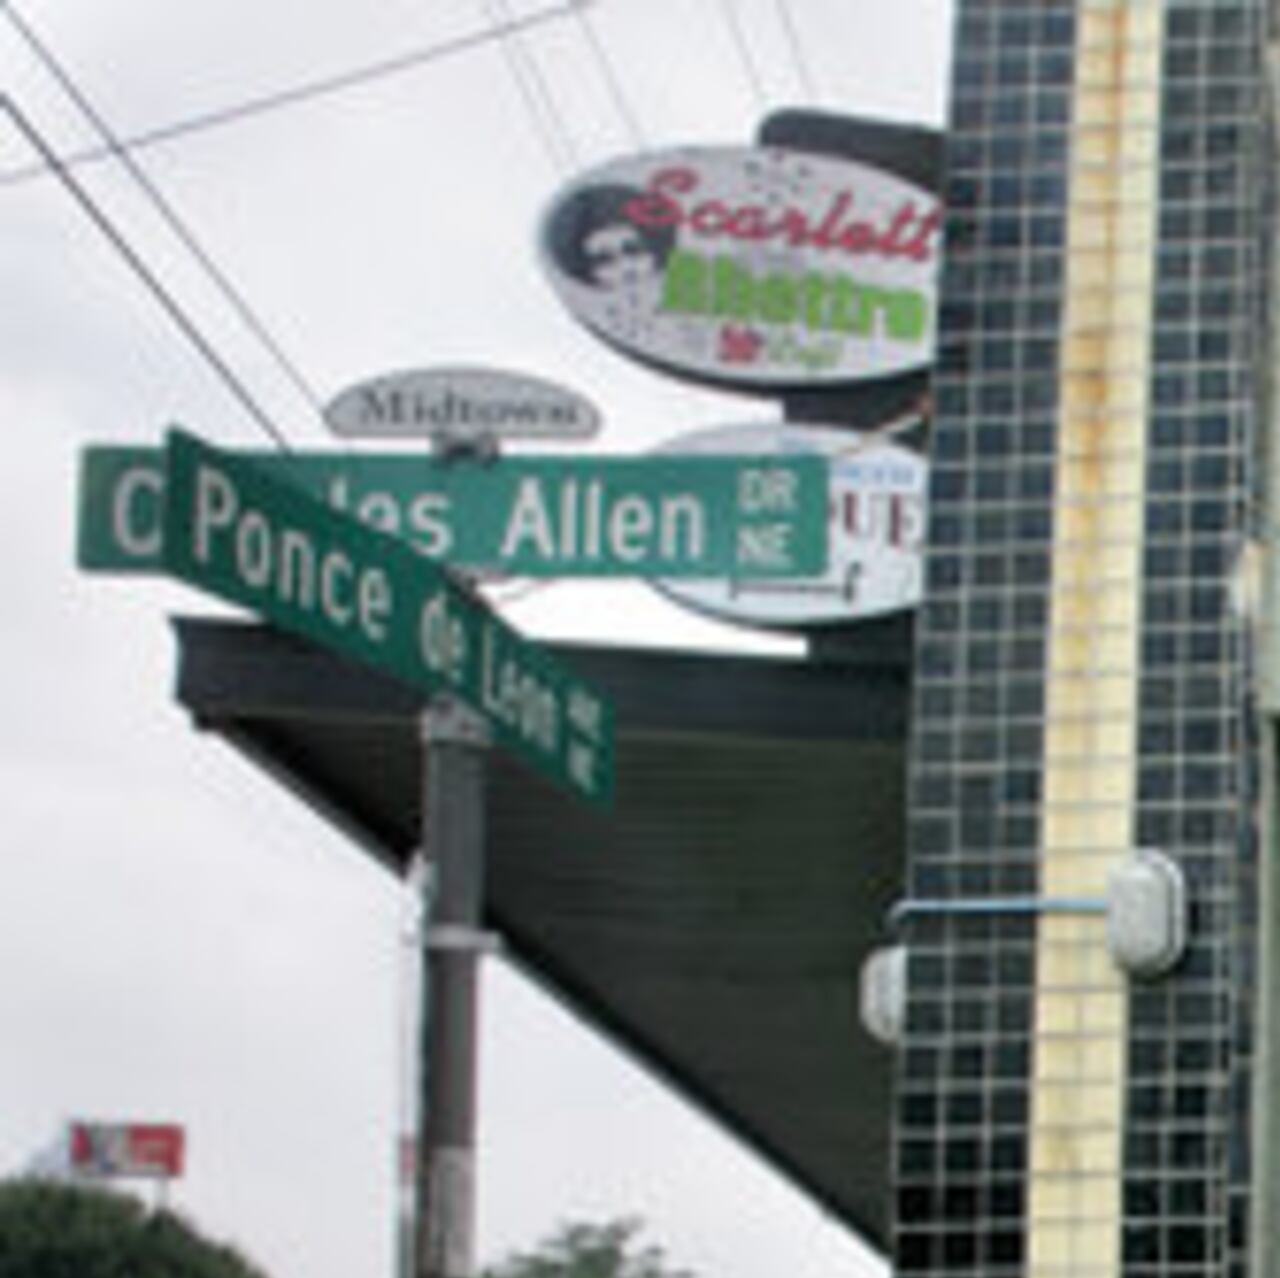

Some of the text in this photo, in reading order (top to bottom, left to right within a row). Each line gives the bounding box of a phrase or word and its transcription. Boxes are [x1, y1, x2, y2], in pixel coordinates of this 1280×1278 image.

[623, 165, 942, 263] Scarlett
[192, 464, 393, 642] Ponce
[499, 475, 706, 563] Allen
